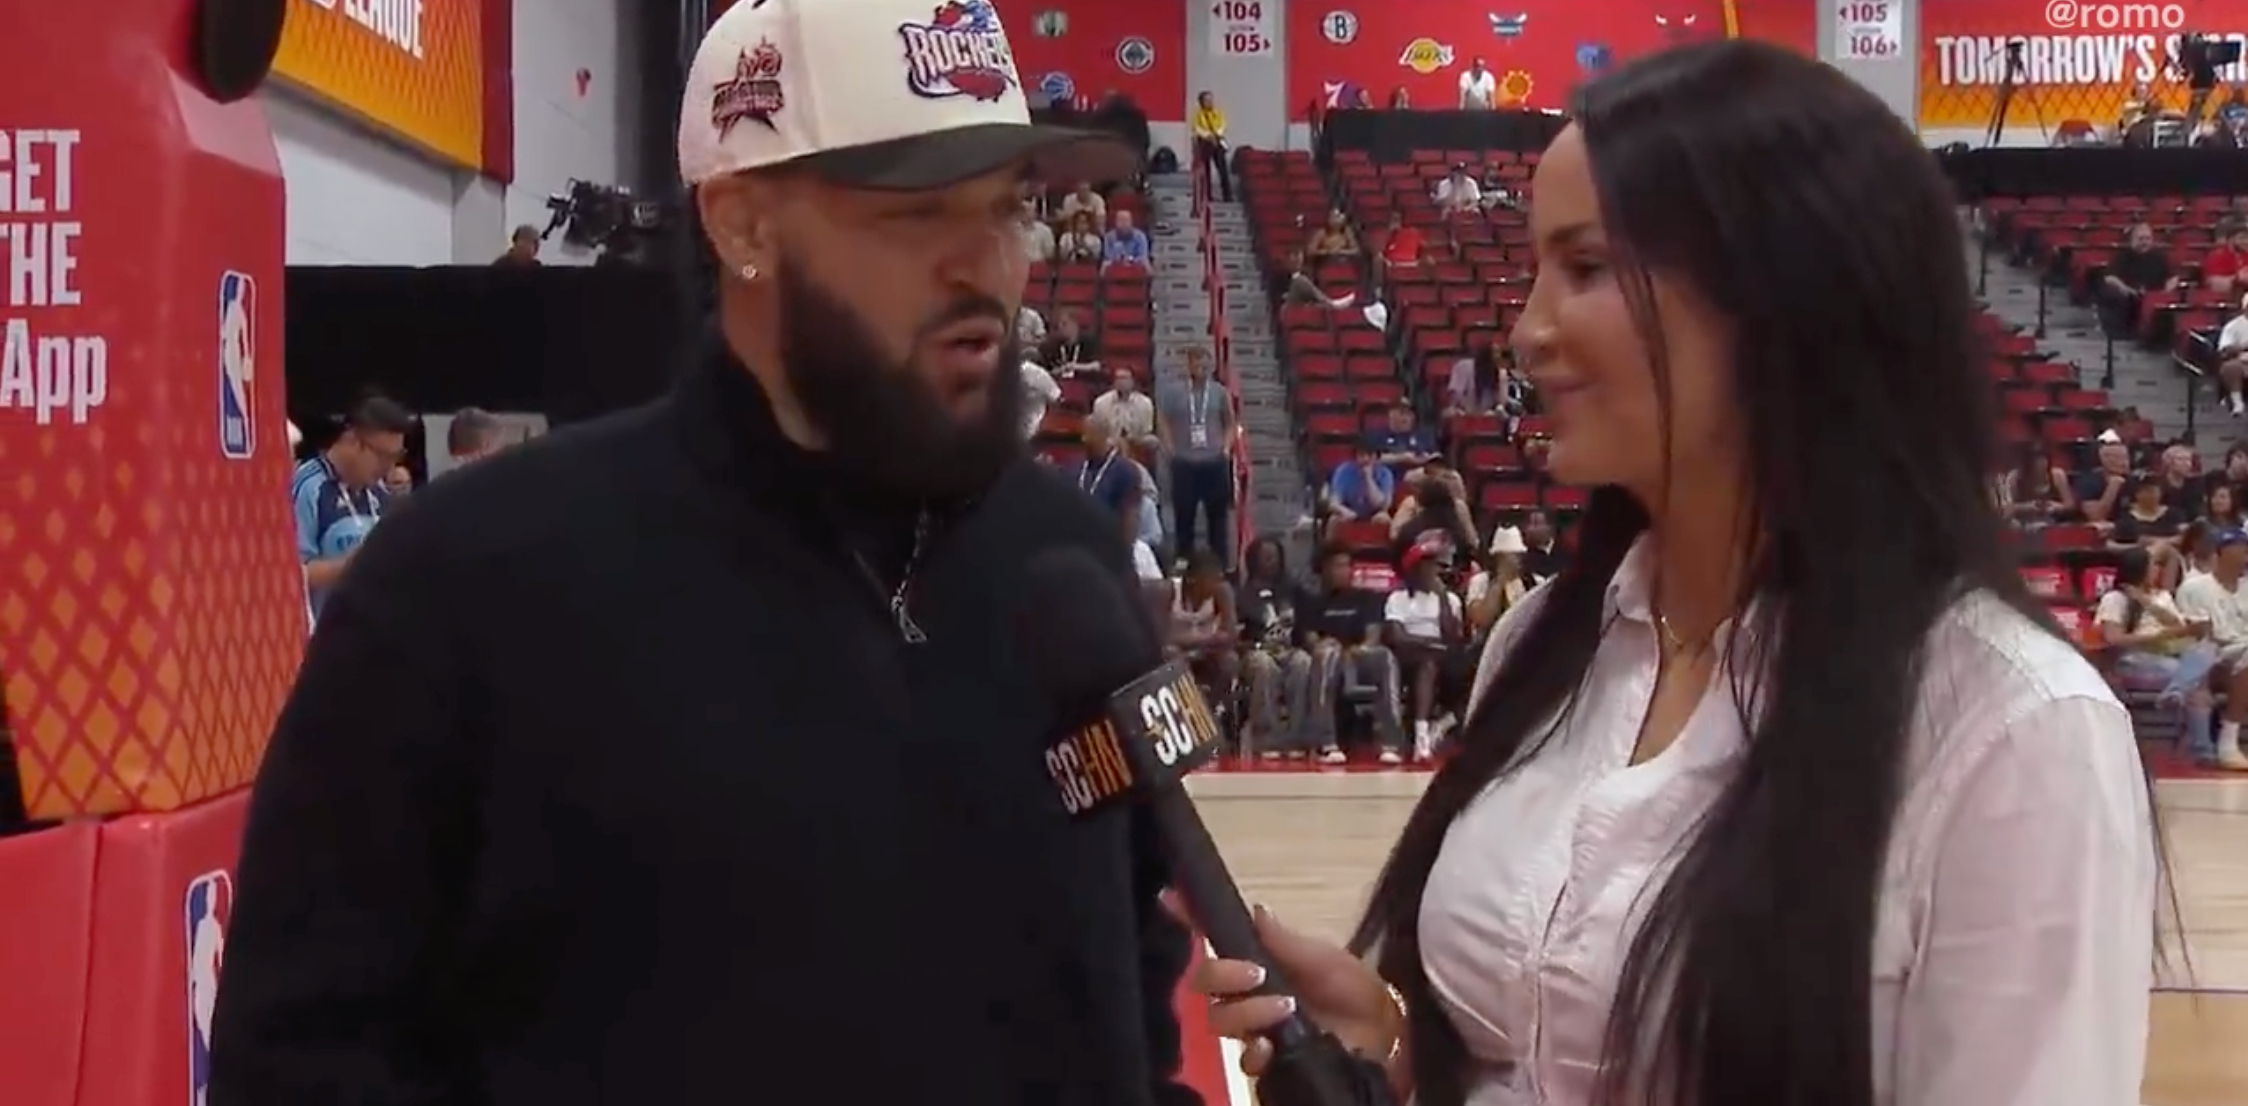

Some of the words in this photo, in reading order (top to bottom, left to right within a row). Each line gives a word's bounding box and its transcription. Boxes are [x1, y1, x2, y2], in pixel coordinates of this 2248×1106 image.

[1224, 0, 1261, 21] 104
[1851, 3, 1887, 23] 105
[1225, 33, 1260, 53] 105
[1852, 35, 1887, 55] 106
[902, 26, 1014, 84] ROCKE
[0, 318, 107, 424] App
[1140, 670, 1218, 766] SCHN
